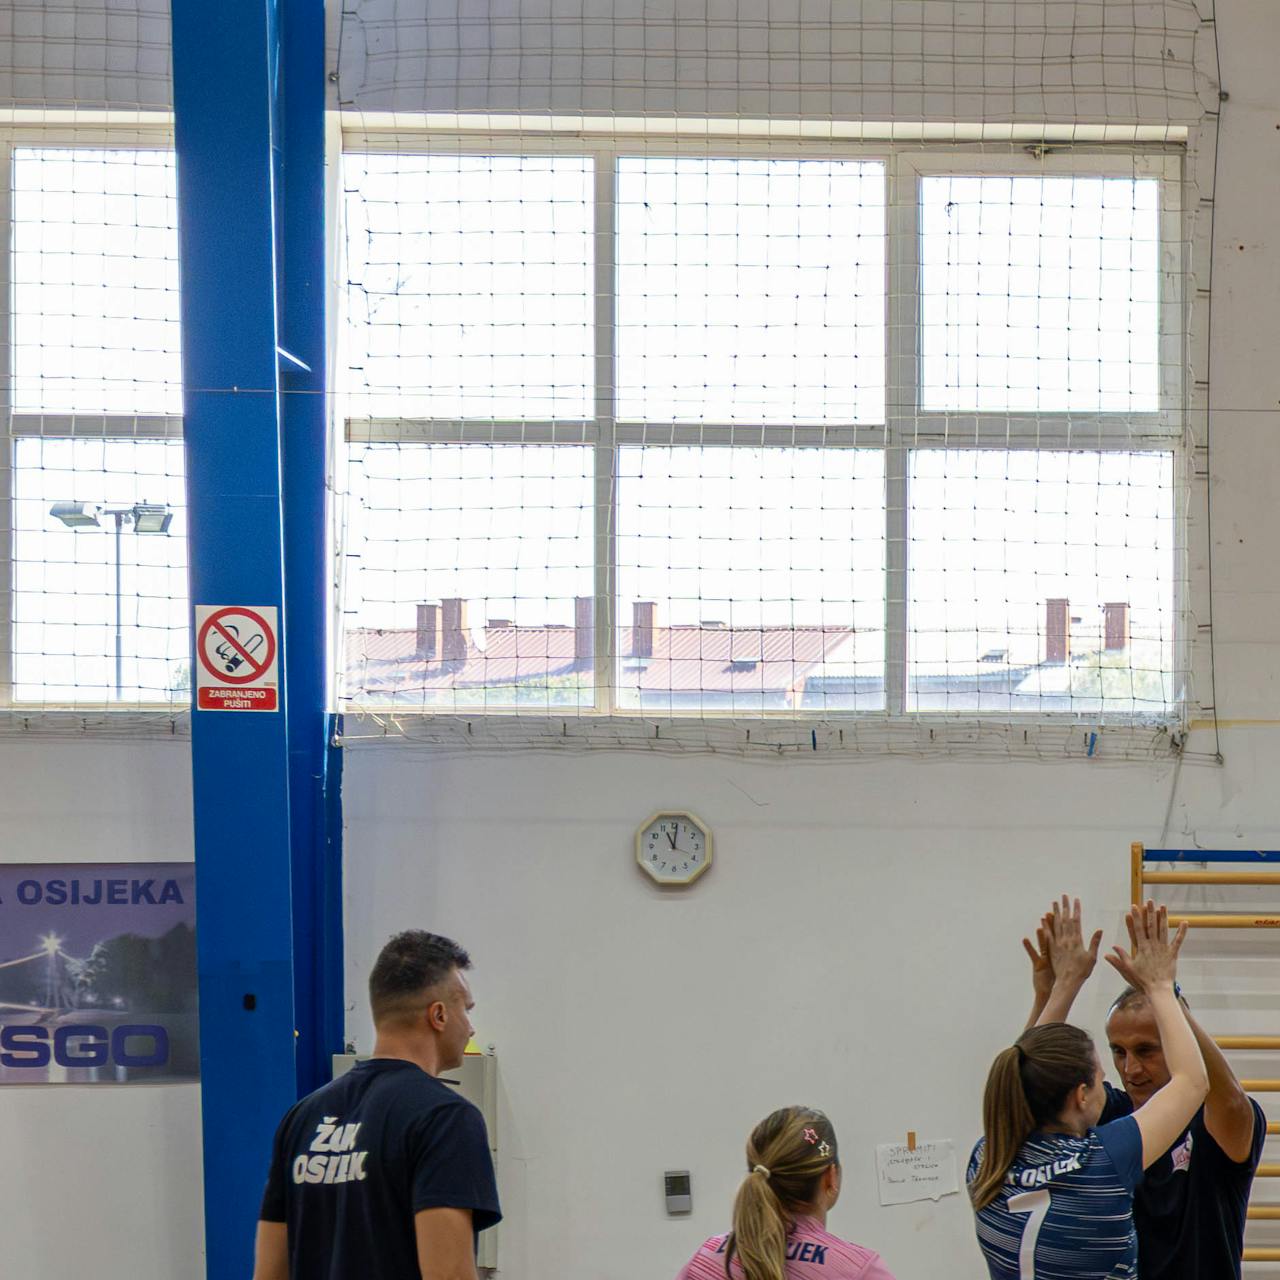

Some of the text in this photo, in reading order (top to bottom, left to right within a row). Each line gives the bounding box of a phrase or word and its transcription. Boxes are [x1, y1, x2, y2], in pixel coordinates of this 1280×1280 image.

[208, 689, 266, 699] ZABRANJENO
[223, 699, 252, 709] PUŠITI
[16, 879, 184, 905] OSIJEKA
[1, 1025, 169, 1067] SGO
